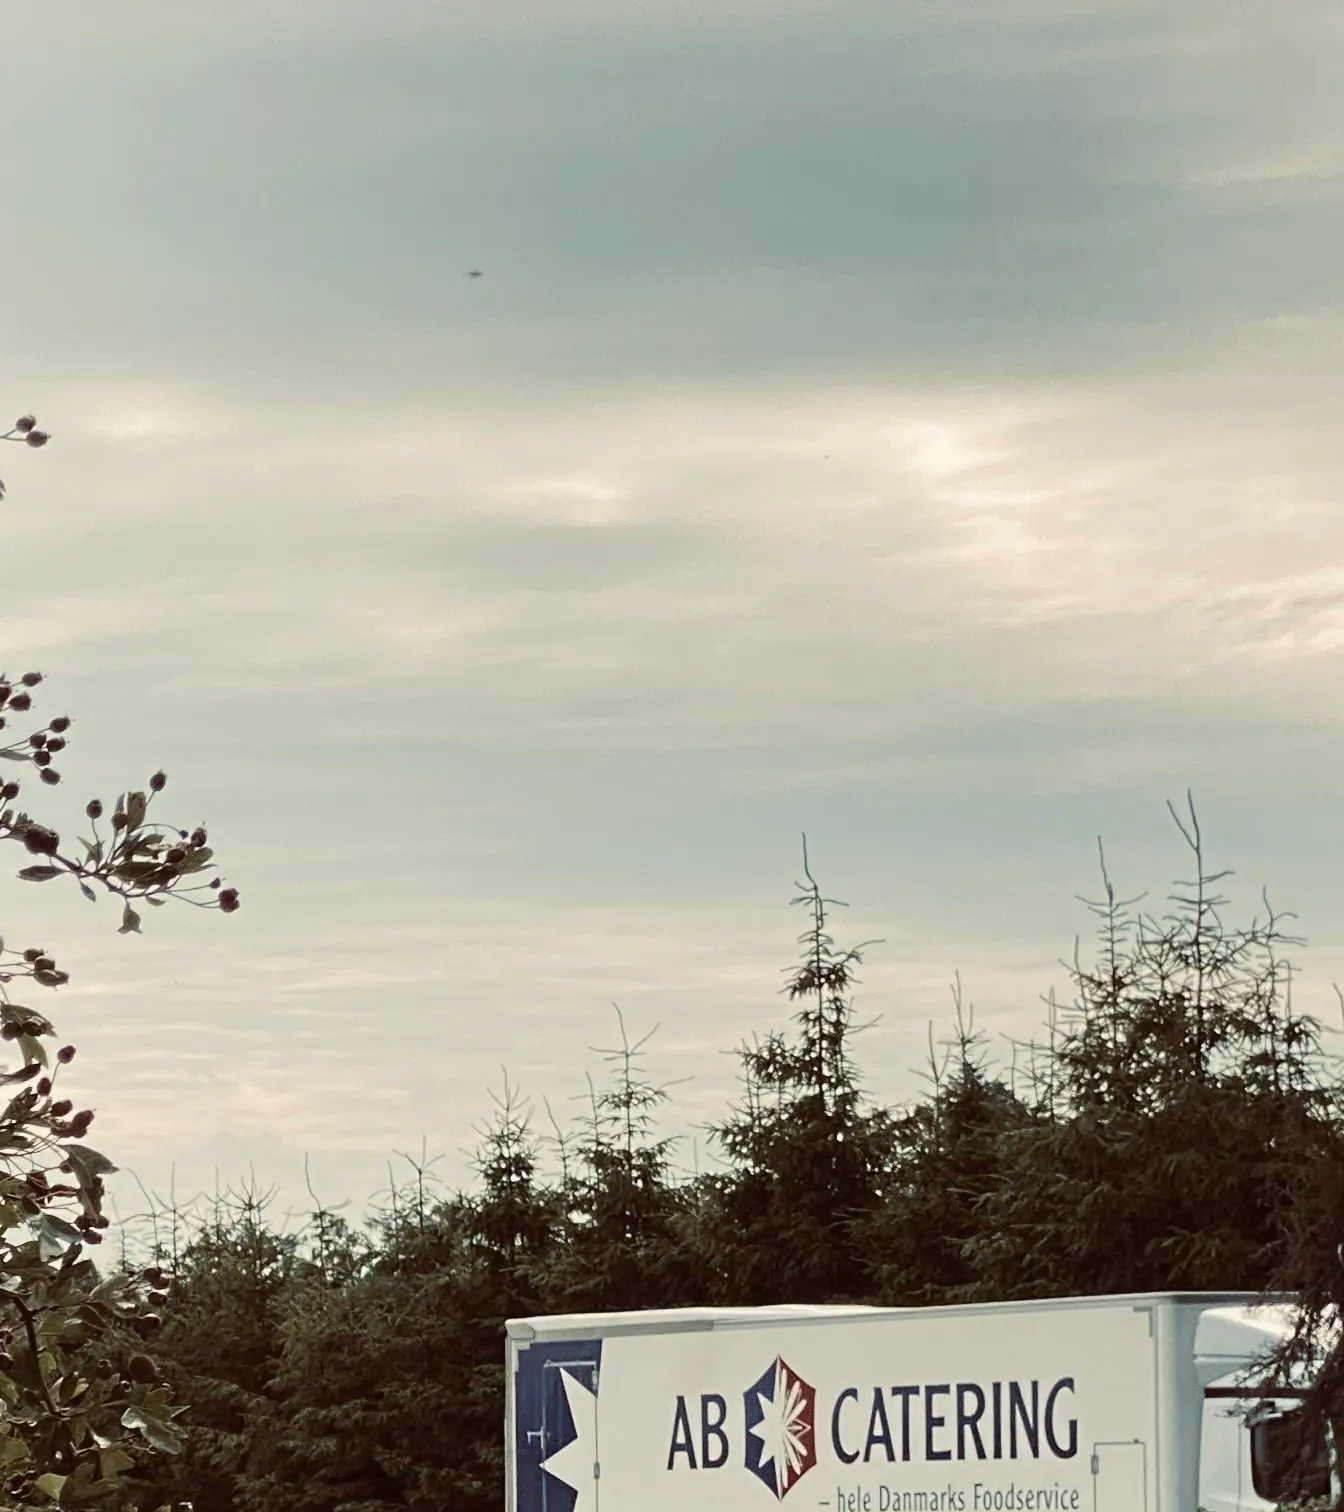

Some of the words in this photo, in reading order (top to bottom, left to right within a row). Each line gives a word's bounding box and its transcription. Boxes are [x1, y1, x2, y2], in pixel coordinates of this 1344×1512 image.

[667, 1394, 730, 1470] AB
[831, 1377, 1079, 1464] CATERING
[837, 1486, 871, 1512] hele
[879, 1484, 965, 1512] Danmarks
[974, 1482, 1080, 1511] Foodservice
